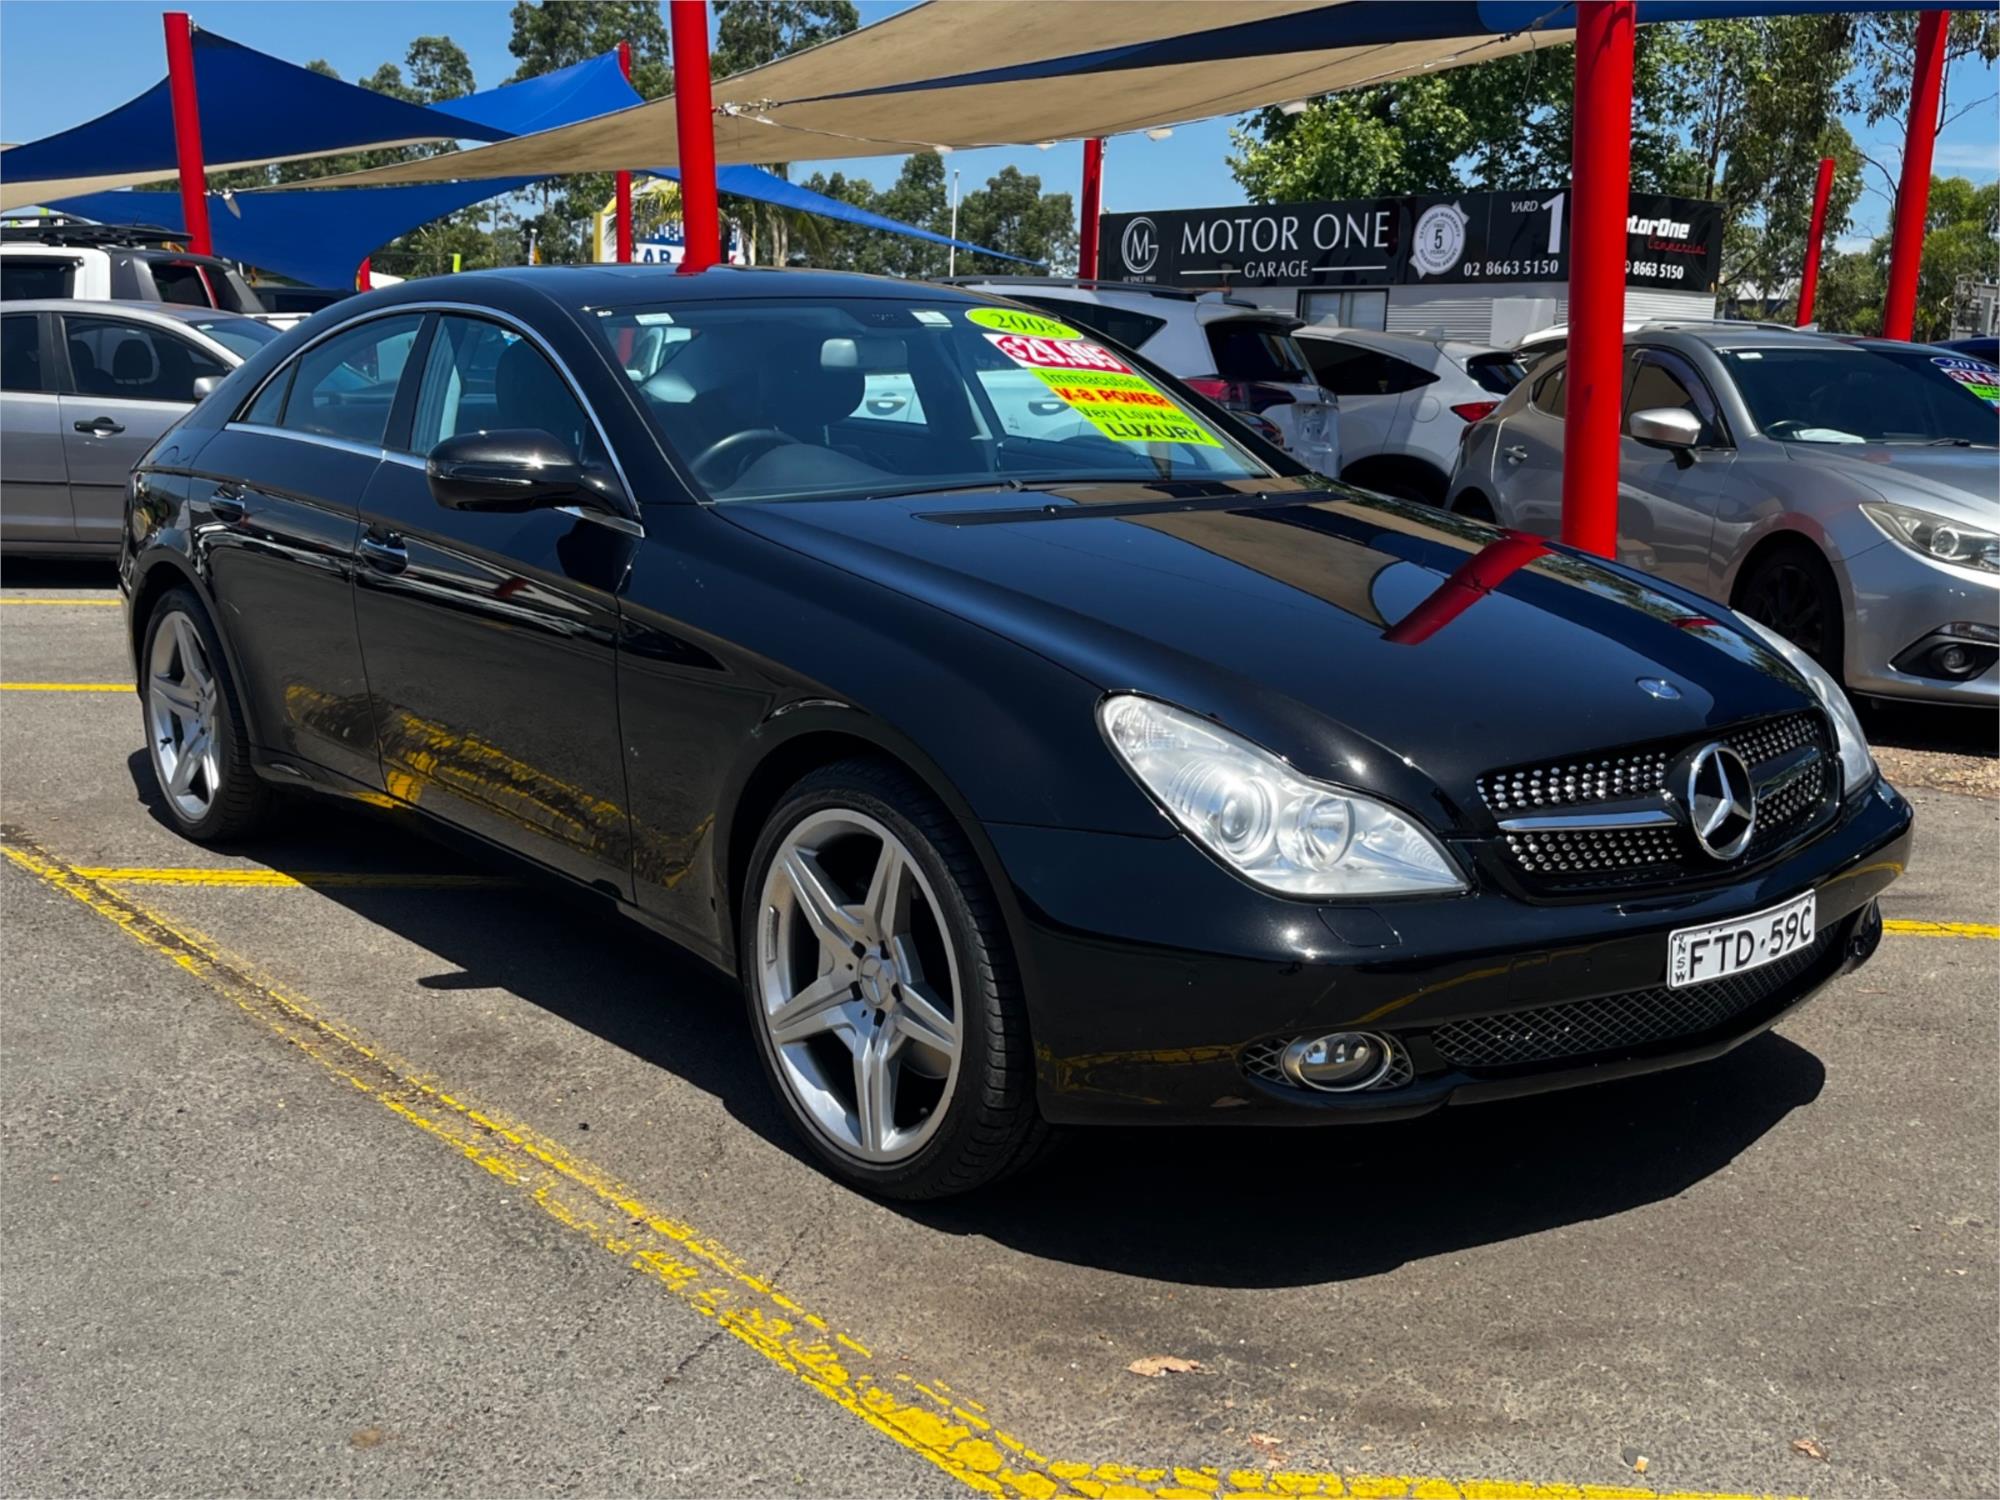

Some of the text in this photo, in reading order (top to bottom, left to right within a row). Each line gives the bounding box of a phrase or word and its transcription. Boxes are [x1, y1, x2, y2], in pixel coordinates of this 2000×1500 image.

[1181, 211, 1390, 254] MOTOR ONE
[1511, 192, 1565, 254] YARD 1
[1627, 215, 1690, 239] torOne
[1434, 228, 1443, 249] 5
[1244, 260, 1309, 279] GARAGE
[1464, 260, 1559, 277] 02 8663 5150
[1632, 261, 1684, 280] 8663 5150
[990, 312, 1063, 336] 2008
[1053, 387, 1173, 408] V-8 POWER
[1078, 405, 1122, 421] Very
[1119, 408, 1158, 421] Low
[1104, 422, 1208, 443] LUXURY
